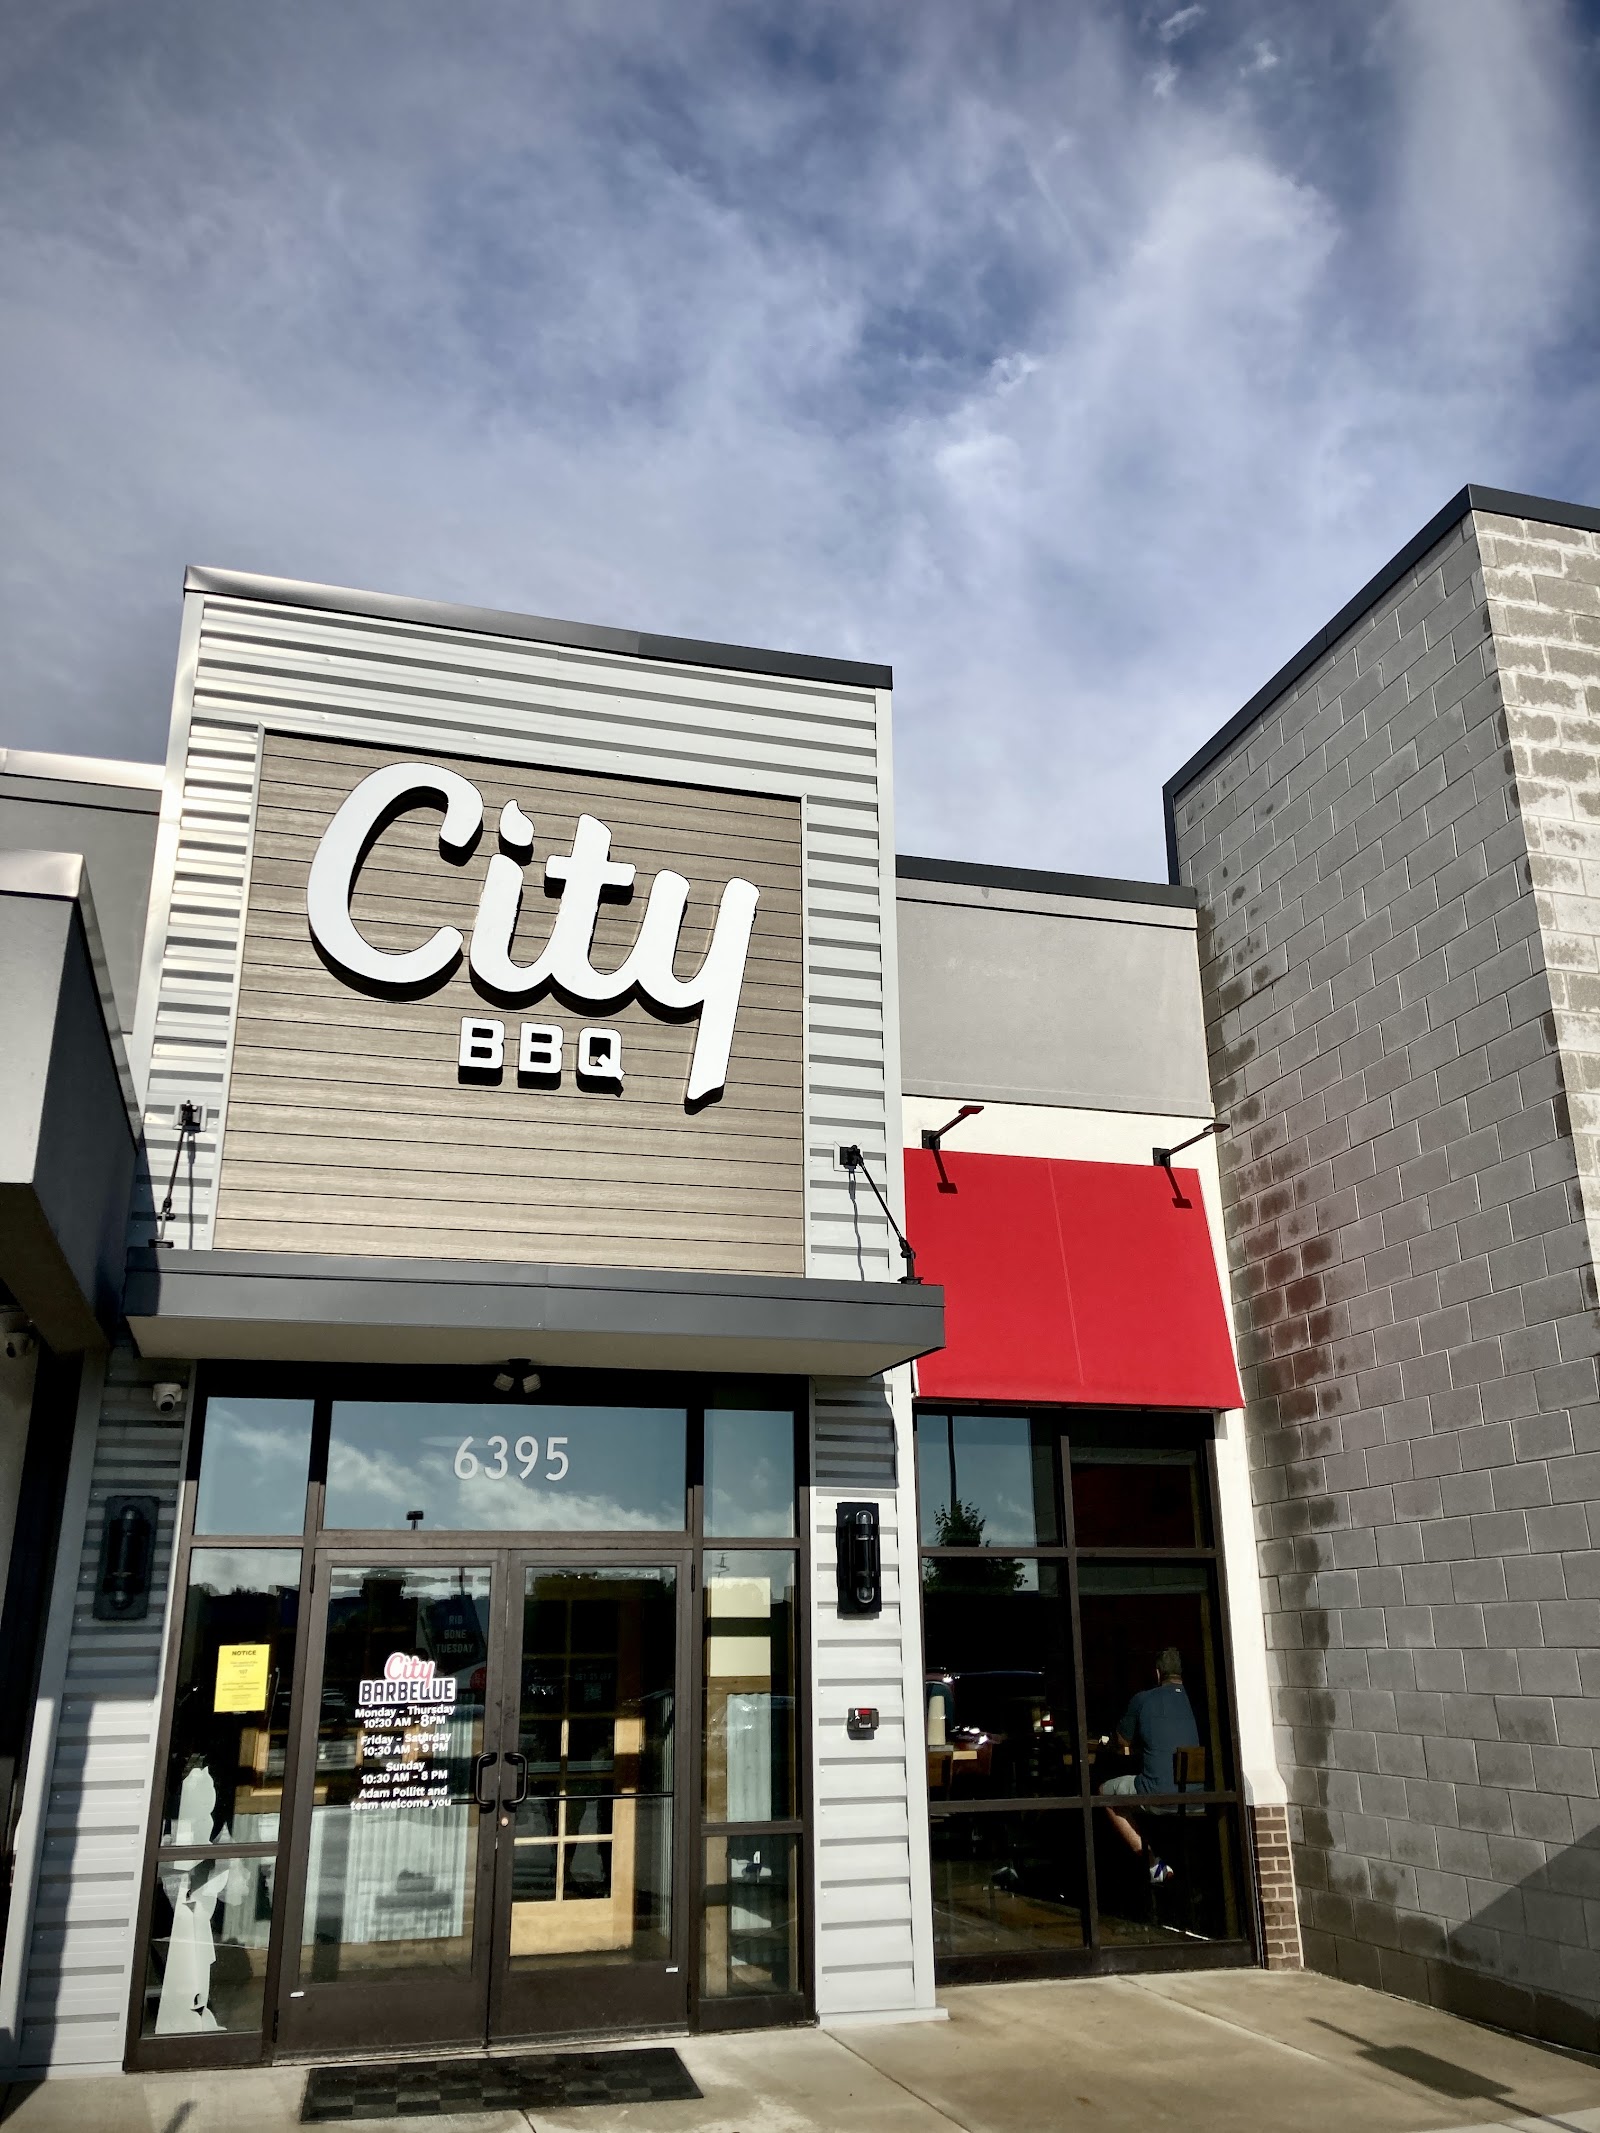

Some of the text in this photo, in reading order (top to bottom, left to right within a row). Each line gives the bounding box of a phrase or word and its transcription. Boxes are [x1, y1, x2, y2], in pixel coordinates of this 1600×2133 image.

[307, 762, 760, 1101] City
[459, 1016, 626, 1081] BBQ
[454, 1435, 569, 1481] 6395
[444, 1629, 467, 1639] BONE
[436, 1643, 474, 1653] TUESDAY
[385, 1653, 435, 1690] City
[360, 1679, 454, 1704] BARBEQUE
[355, 1708, 397, 1719] Monday
[407, 1704, 455, 1716] Thursday
[363, 1717, 392, 1728] 10:30
[394, 1717, 411, 1727] AM
[361, 1734, 394, 1746] Friday
[404, 1732, 452, 1744] Saturday
[363, 1745, 391, 1756] 10:30
[393, 1744, 411, 1755] AM
[422, 1744, 429, 1753] 9
[432, 1743, 449, 1752] PM
[386, 1761, 426, 1772] Sunday
[361, 1774, 390, 1784] 10:30
[392, 1772, 410, 1782] AM
[421, 1771, 428, 1780] 8
[431, 1770, 448, 1779] PM
[359, 1785, 448, 1798] Adam Pollitt and
[350, 1798, 452, 1810] team welcome you
